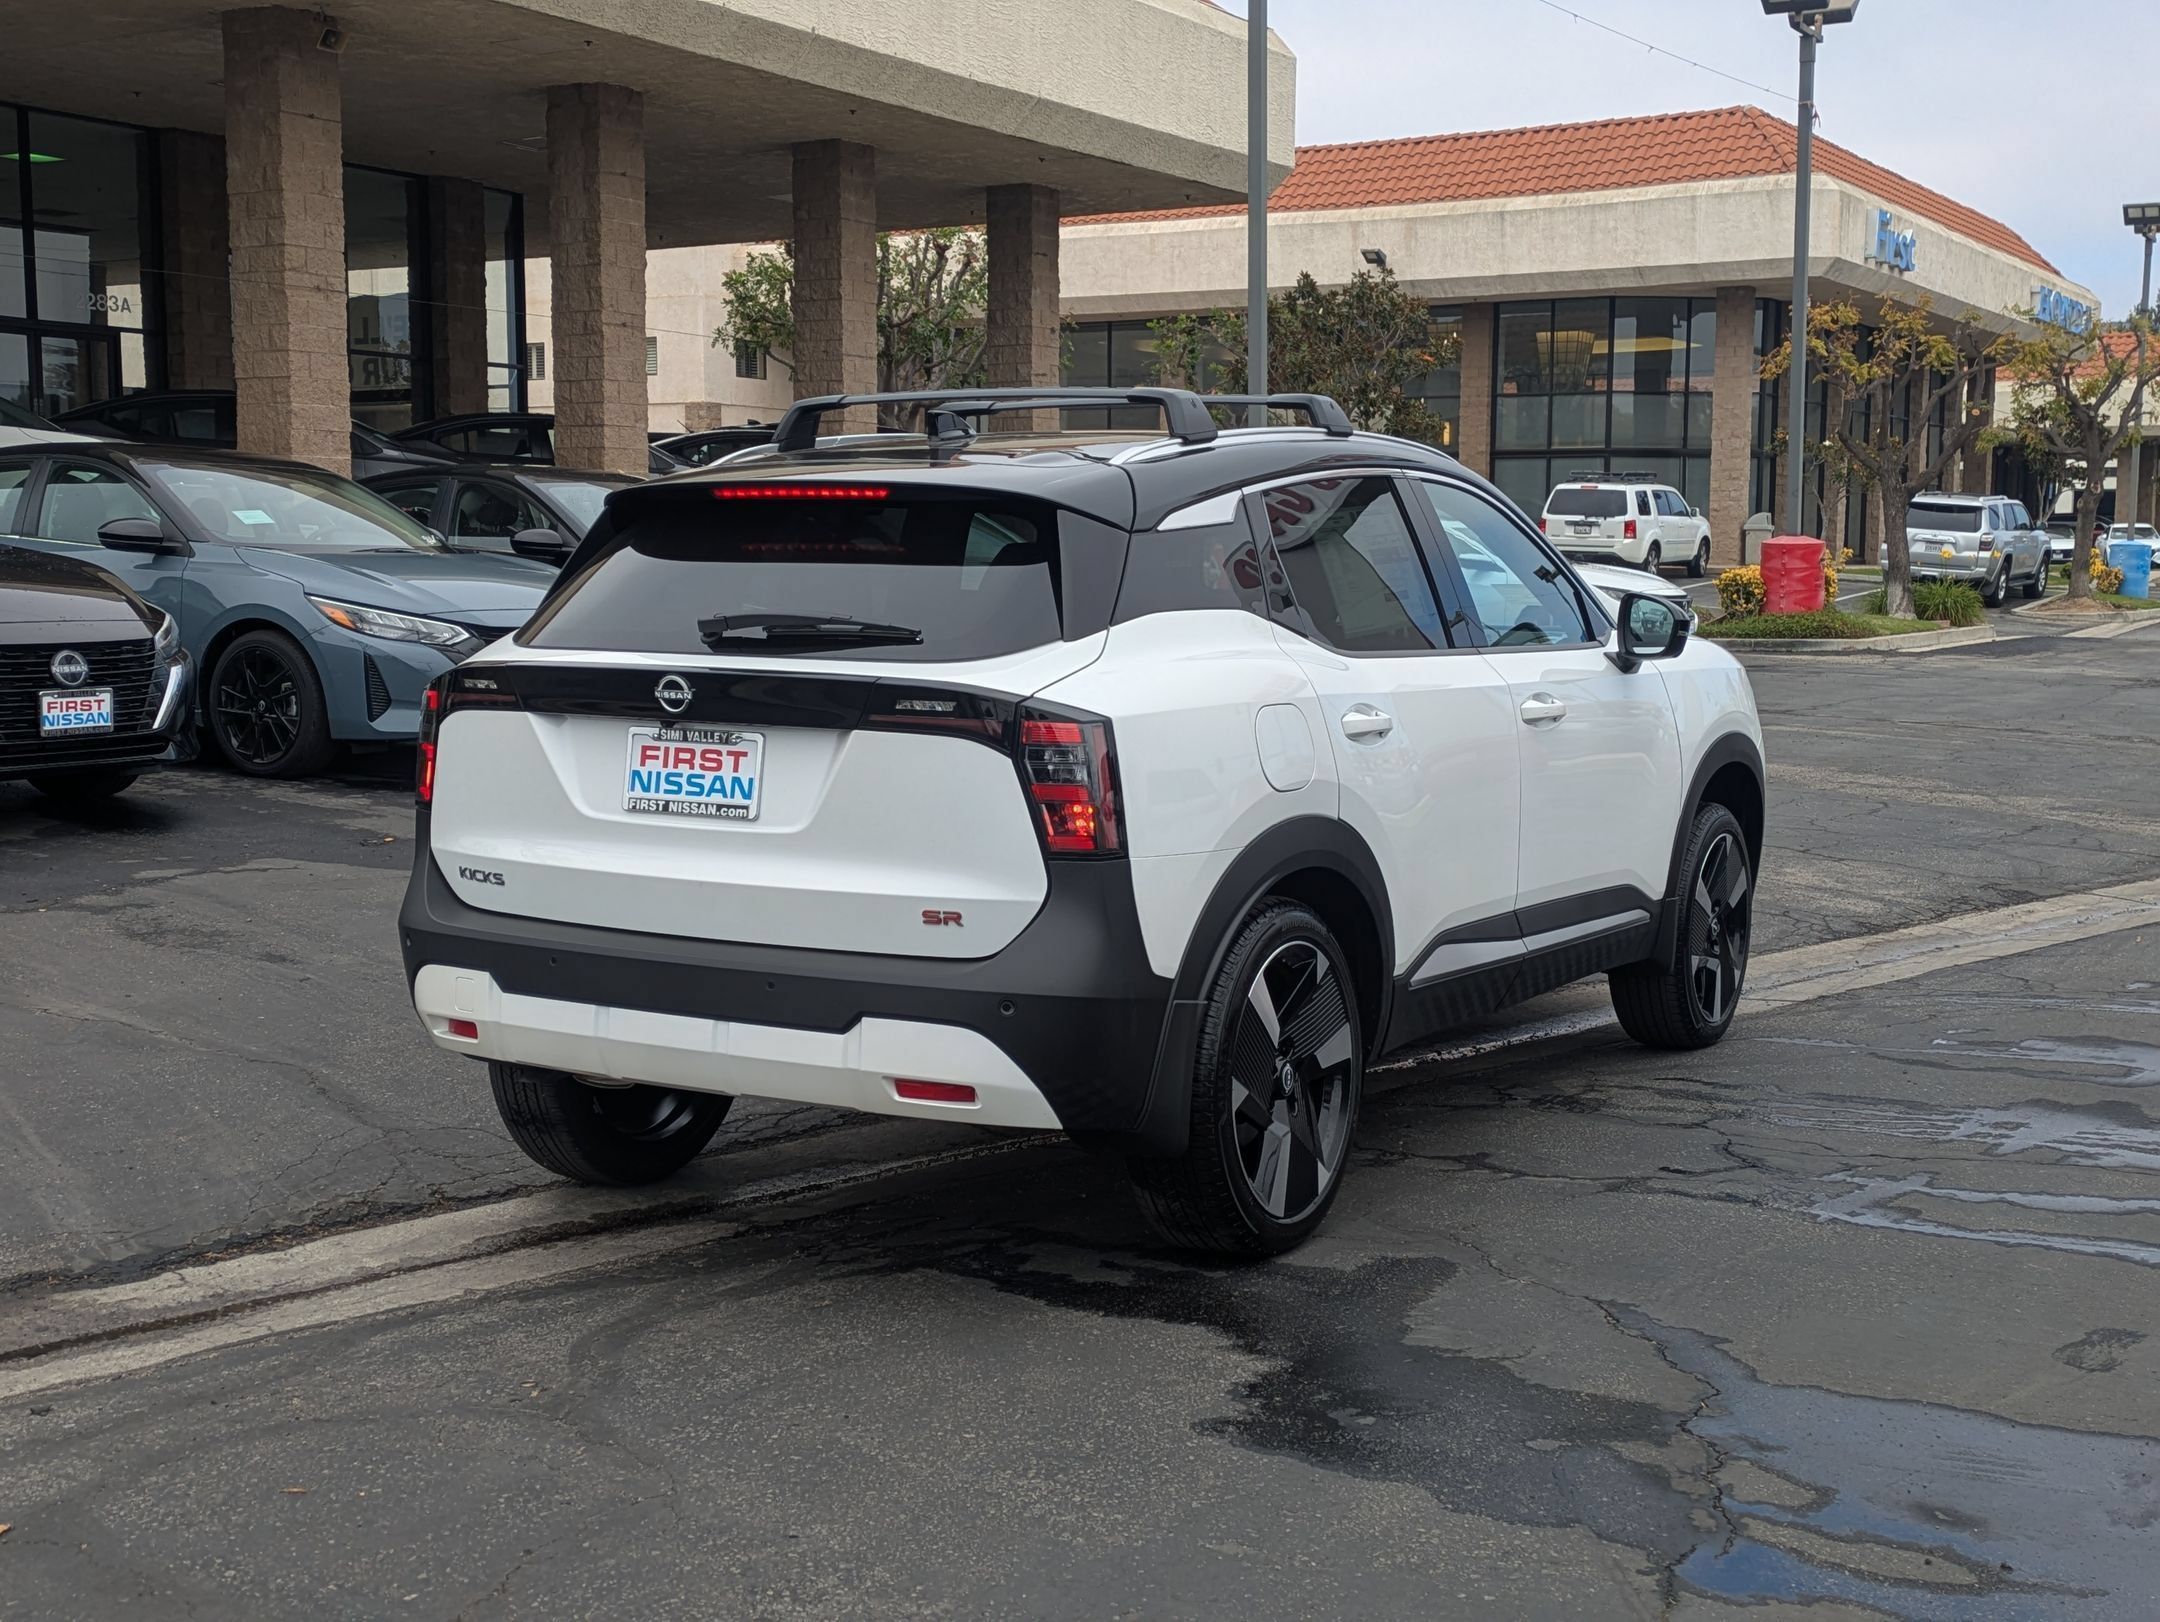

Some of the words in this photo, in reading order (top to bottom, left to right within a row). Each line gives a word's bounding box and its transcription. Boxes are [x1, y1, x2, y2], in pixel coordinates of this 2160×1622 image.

[1875, 208, 1916, 271] First
[72, 291, 132, 313] 2283A
[52, 665, 88, 673] NISSAN
[654, 690, 692, 699] NISSAN
[47, 699, 105, 713] FIRST
[42, 712, 110, 727] NISSAN
[661, 728, 683, 741] SIMI
[686, 731, 728, 743] VALLEY
[640, 745, 748, 773] FIRST
[630, 769, 754, 800] NISSAN
[629, 799, 665, 811] FIRST
[668, 801, 748, 818] NISSAN.com
[459, 866, 505, 886] KICKS
[922, 909, 964, 927] SR
